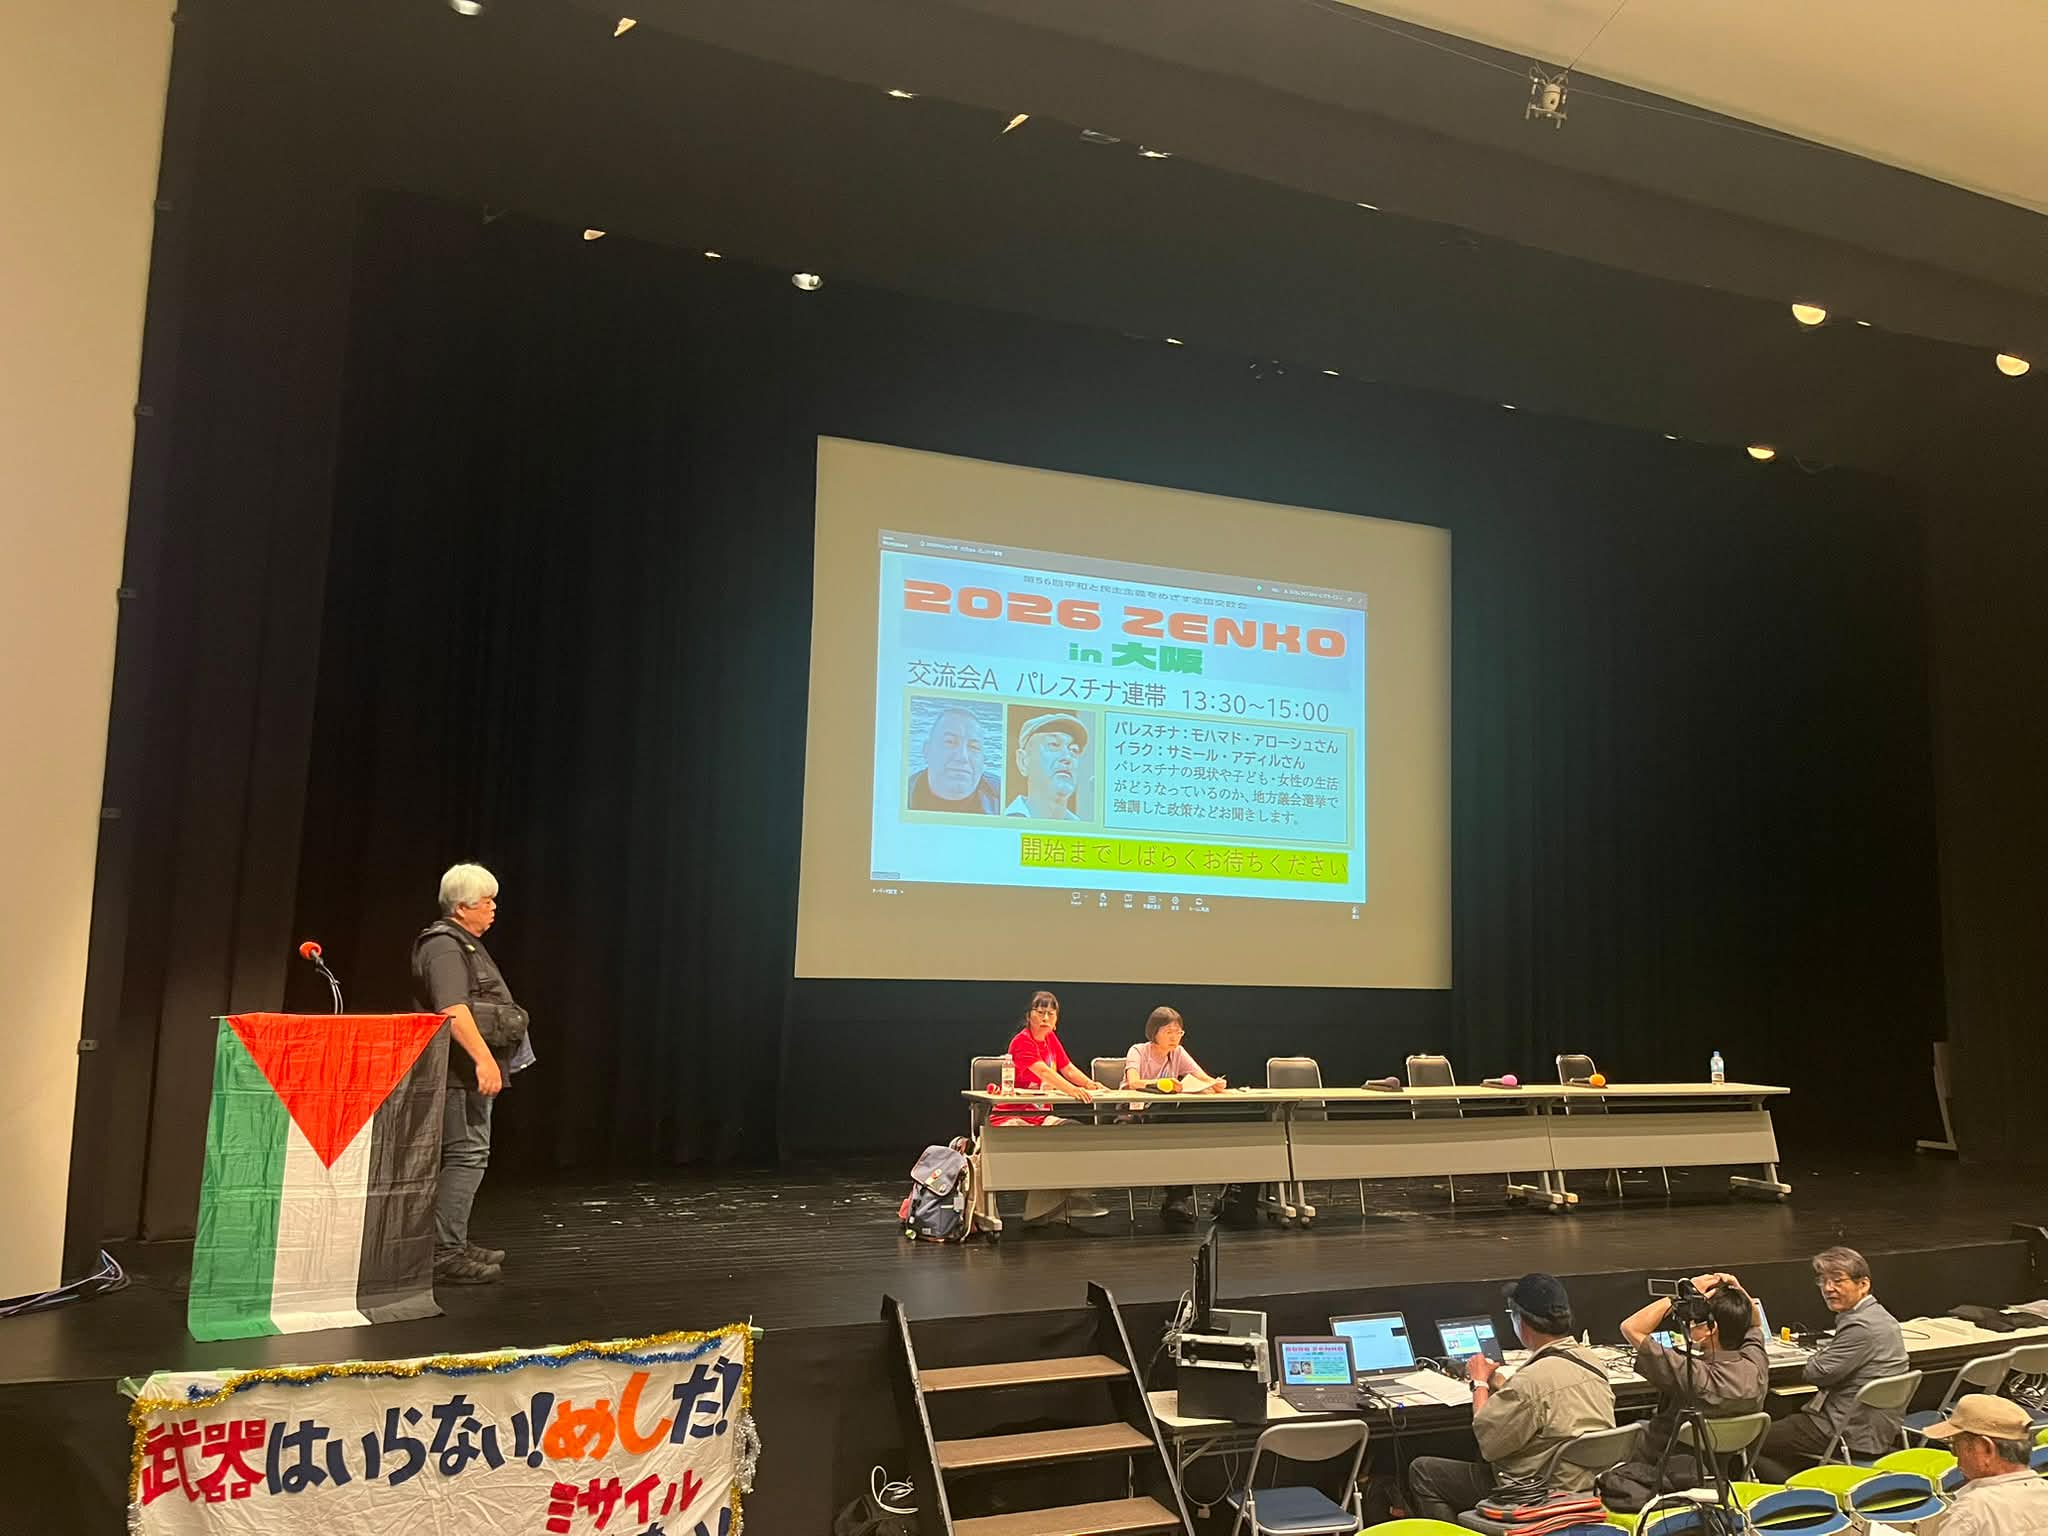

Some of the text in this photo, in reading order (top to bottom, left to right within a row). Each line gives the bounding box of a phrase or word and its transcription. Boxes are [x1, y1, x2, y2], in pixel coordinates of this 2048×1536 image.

[903, 579, 1347, 659] 2026 ZENKO
[1069, 643, 1204, 675] in 大阪
[907, 660, 999, 692] 交流会A
[1016, 671, 1167, 709] パレスチナ連帯
[1021, 836, 1348, 878] 開始までしばらくお待ちください
[546, 1469, 703, 1534] ミサイル
